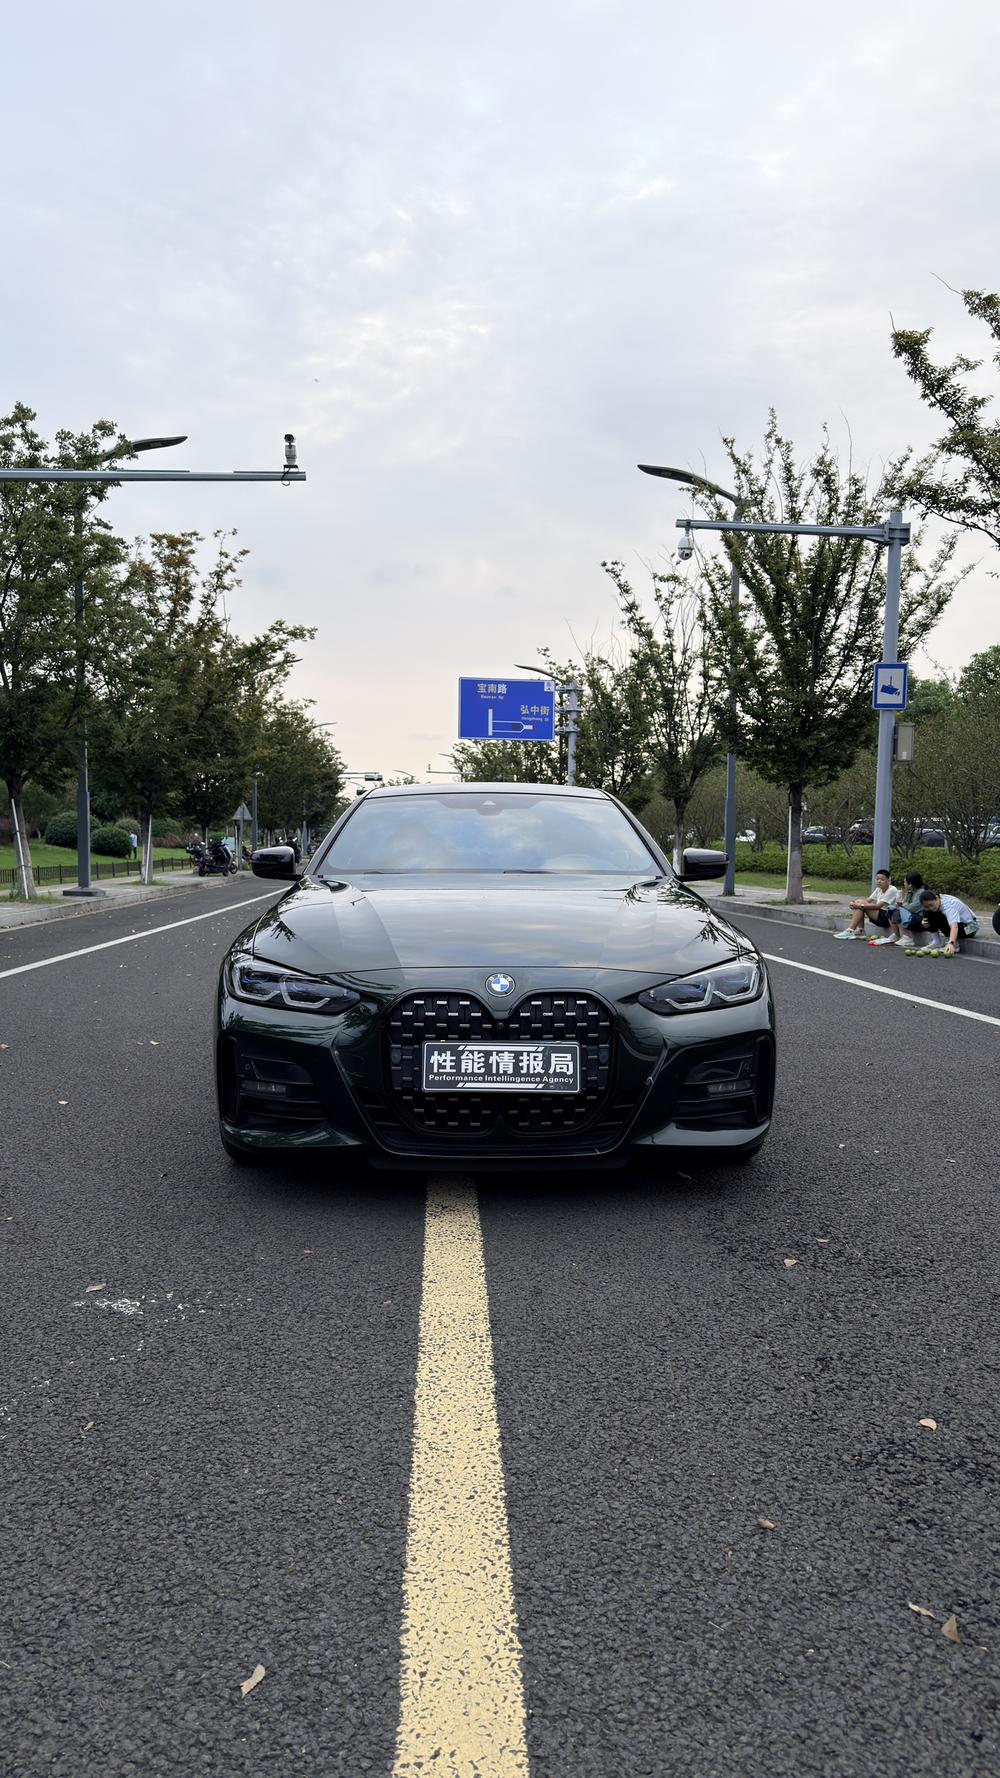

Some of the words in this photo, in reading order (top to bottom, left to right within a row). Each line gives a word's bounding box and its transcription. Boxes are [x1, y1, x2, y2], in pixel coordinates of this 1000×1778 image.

[477, 683, 507, 694] 宝南路
[520, 704, 550, 716] 弘中街
[430, 1051, 574, 1075] 性能情报局
[485, 1074, 541, 1083] Intellingence
[542, 1075, 574, 1085] Agency
